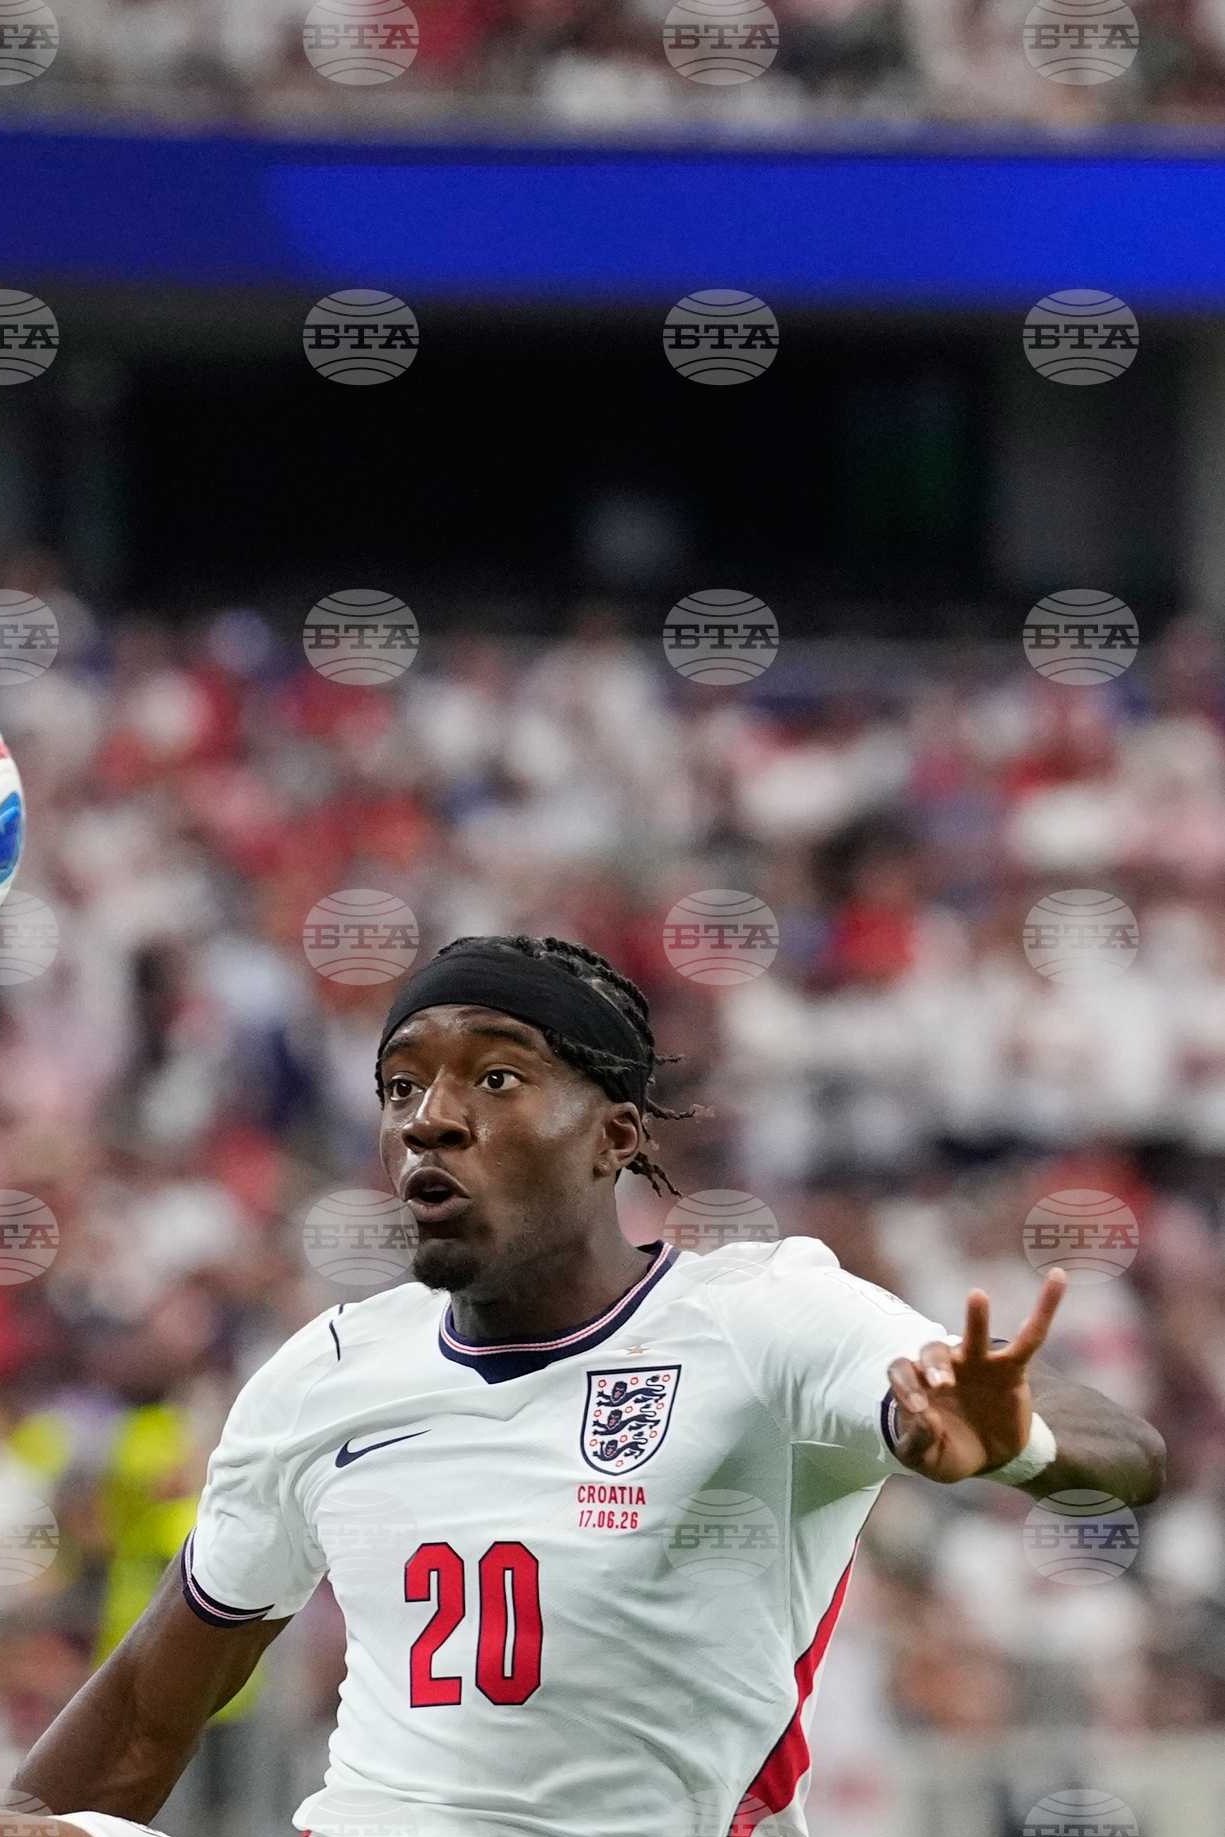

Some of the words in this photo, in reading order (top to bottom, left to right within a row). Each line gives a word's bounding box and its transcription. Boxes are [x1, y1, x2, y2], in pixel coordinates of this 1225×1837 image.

[577, 1485, 646, 1505] CROATIA
[579, 1510, 639, 1529] 17.06.26
[404, 1541, 543, 1708] 20
